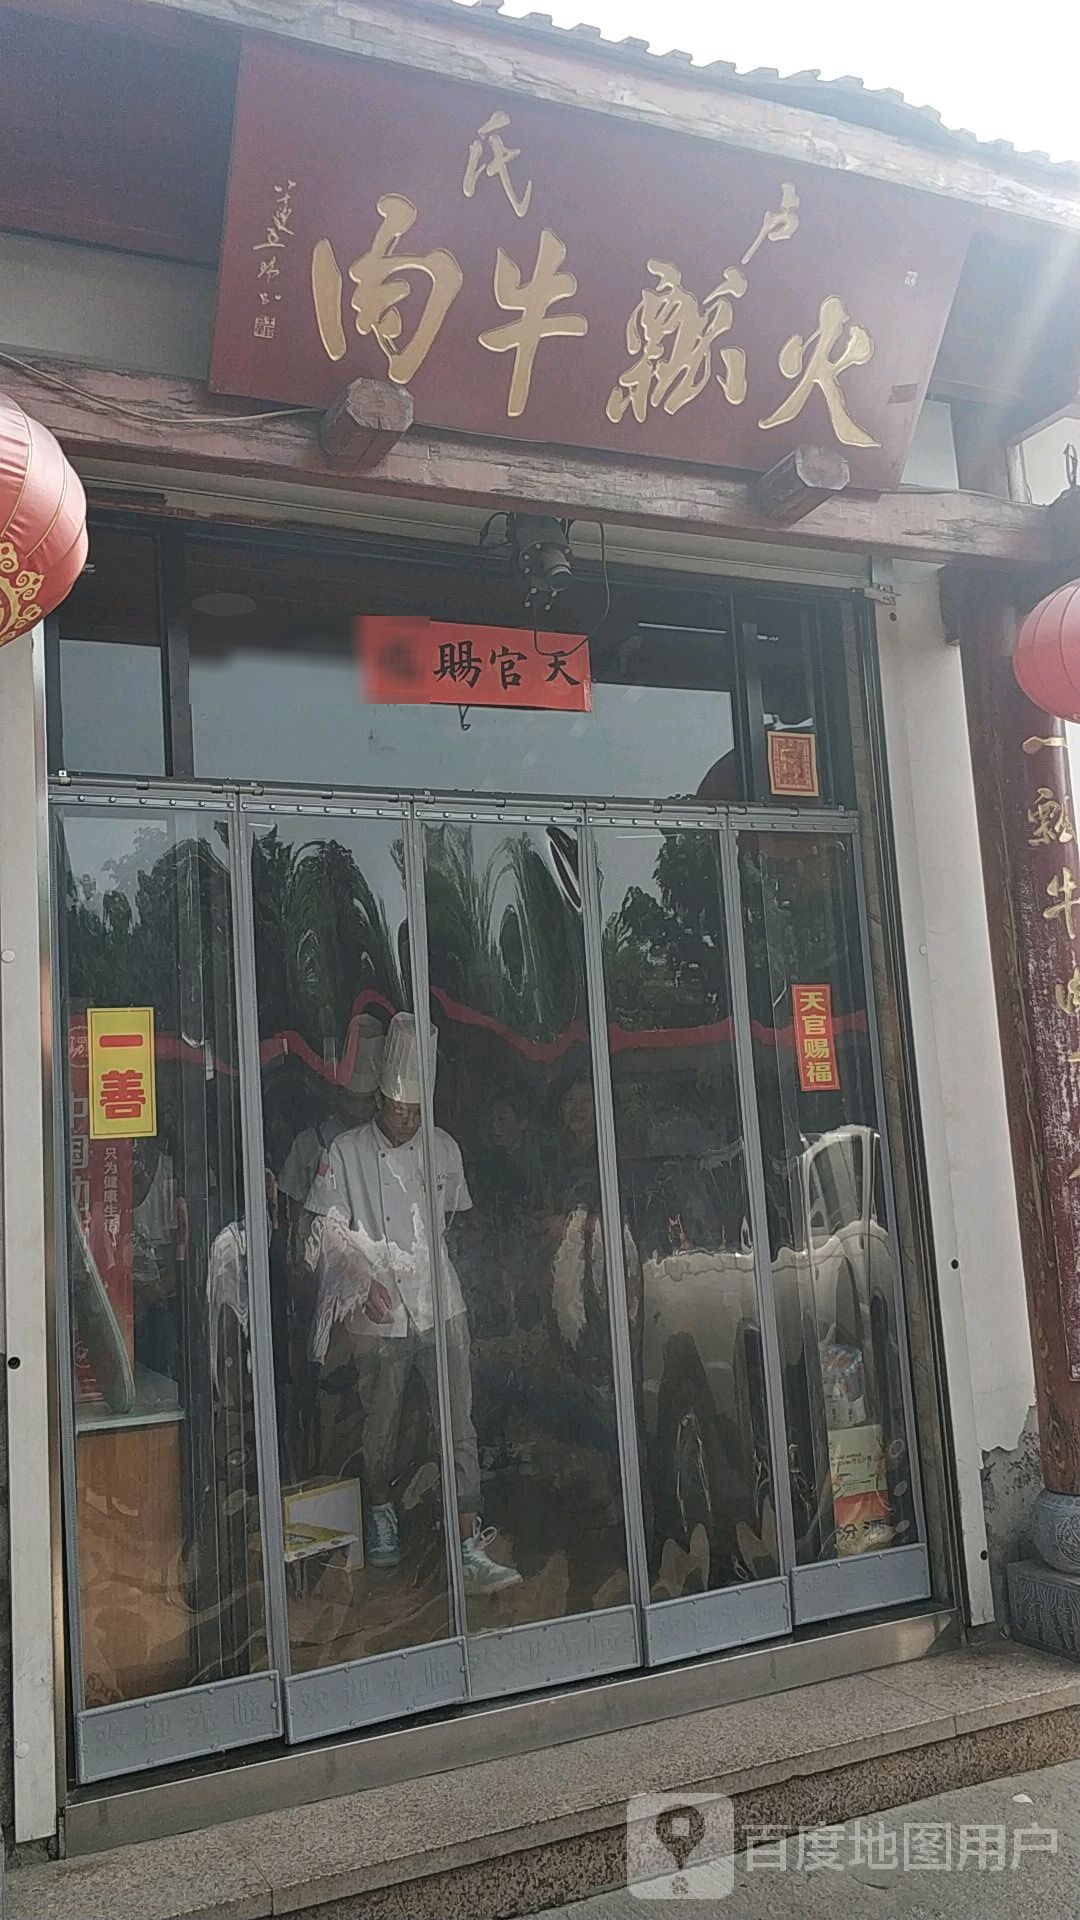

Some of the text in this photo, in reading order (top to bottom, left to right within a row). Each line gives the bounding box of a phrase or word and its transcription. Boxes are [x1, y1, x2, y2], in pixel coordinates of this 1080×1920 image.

[378, 640, 582, 692] 天官賜
[99, 1033, 147, 1121] 一善
[799, 991, 833, 1083] 天官赐福
